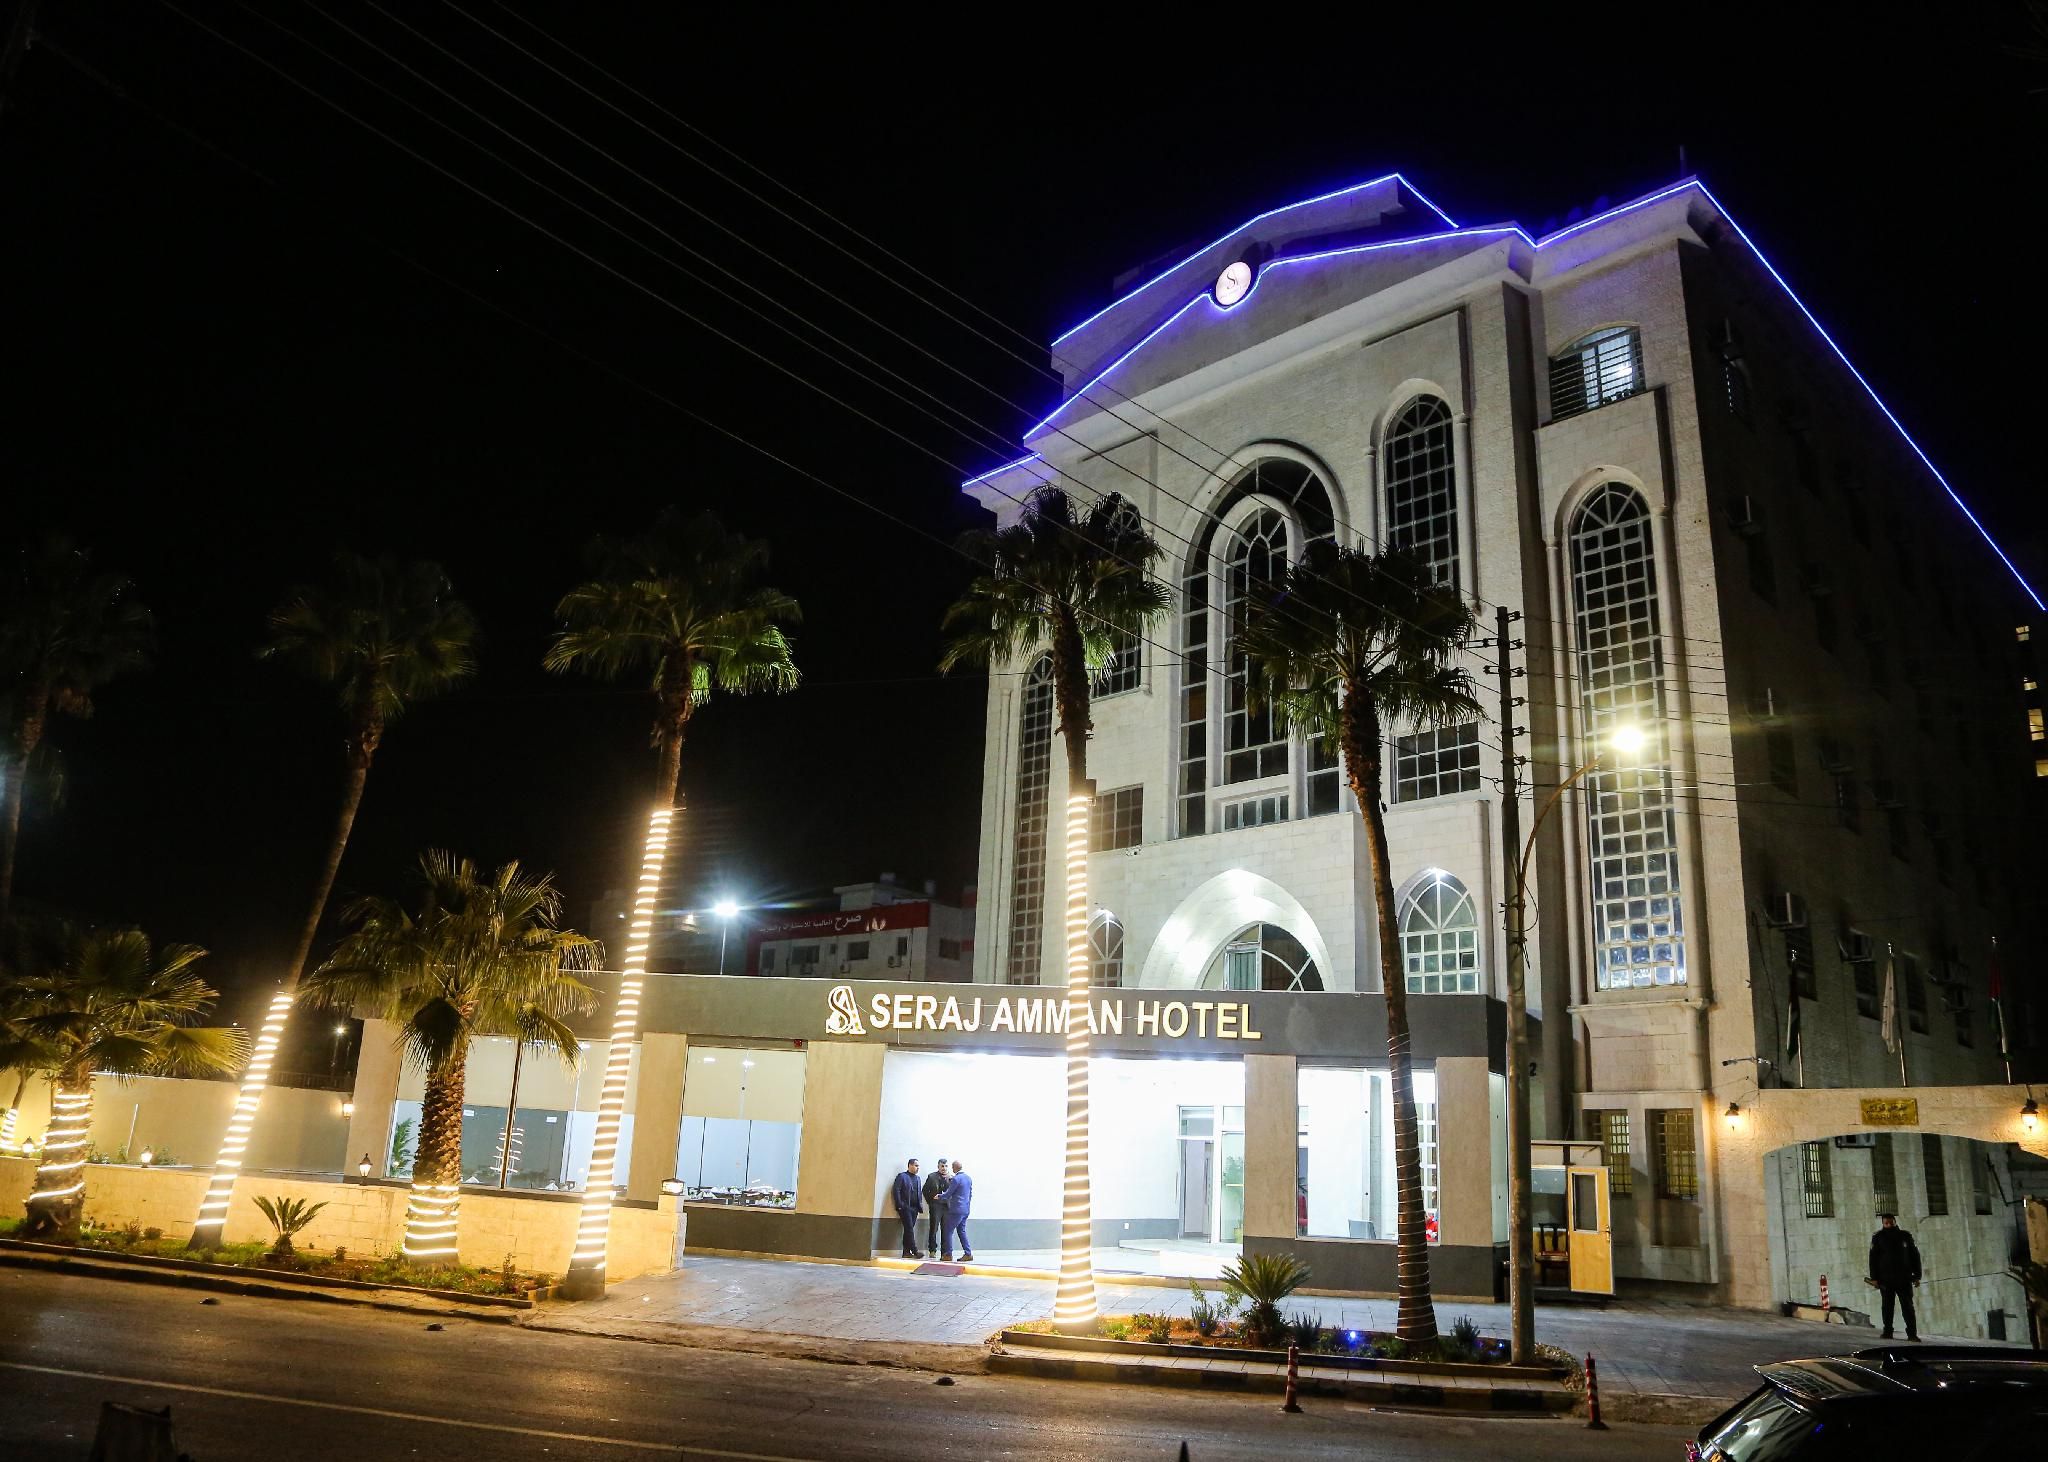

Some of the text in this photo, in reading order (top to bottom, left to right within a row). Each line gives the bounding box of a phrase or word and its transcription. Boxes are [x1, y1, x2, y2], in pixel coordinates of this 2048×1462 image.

[834, 915, 862, 931] صرح
[869, 994, 983, 1031] SERAJ
[1137, 1000, 1262, 1040] HOTEL
